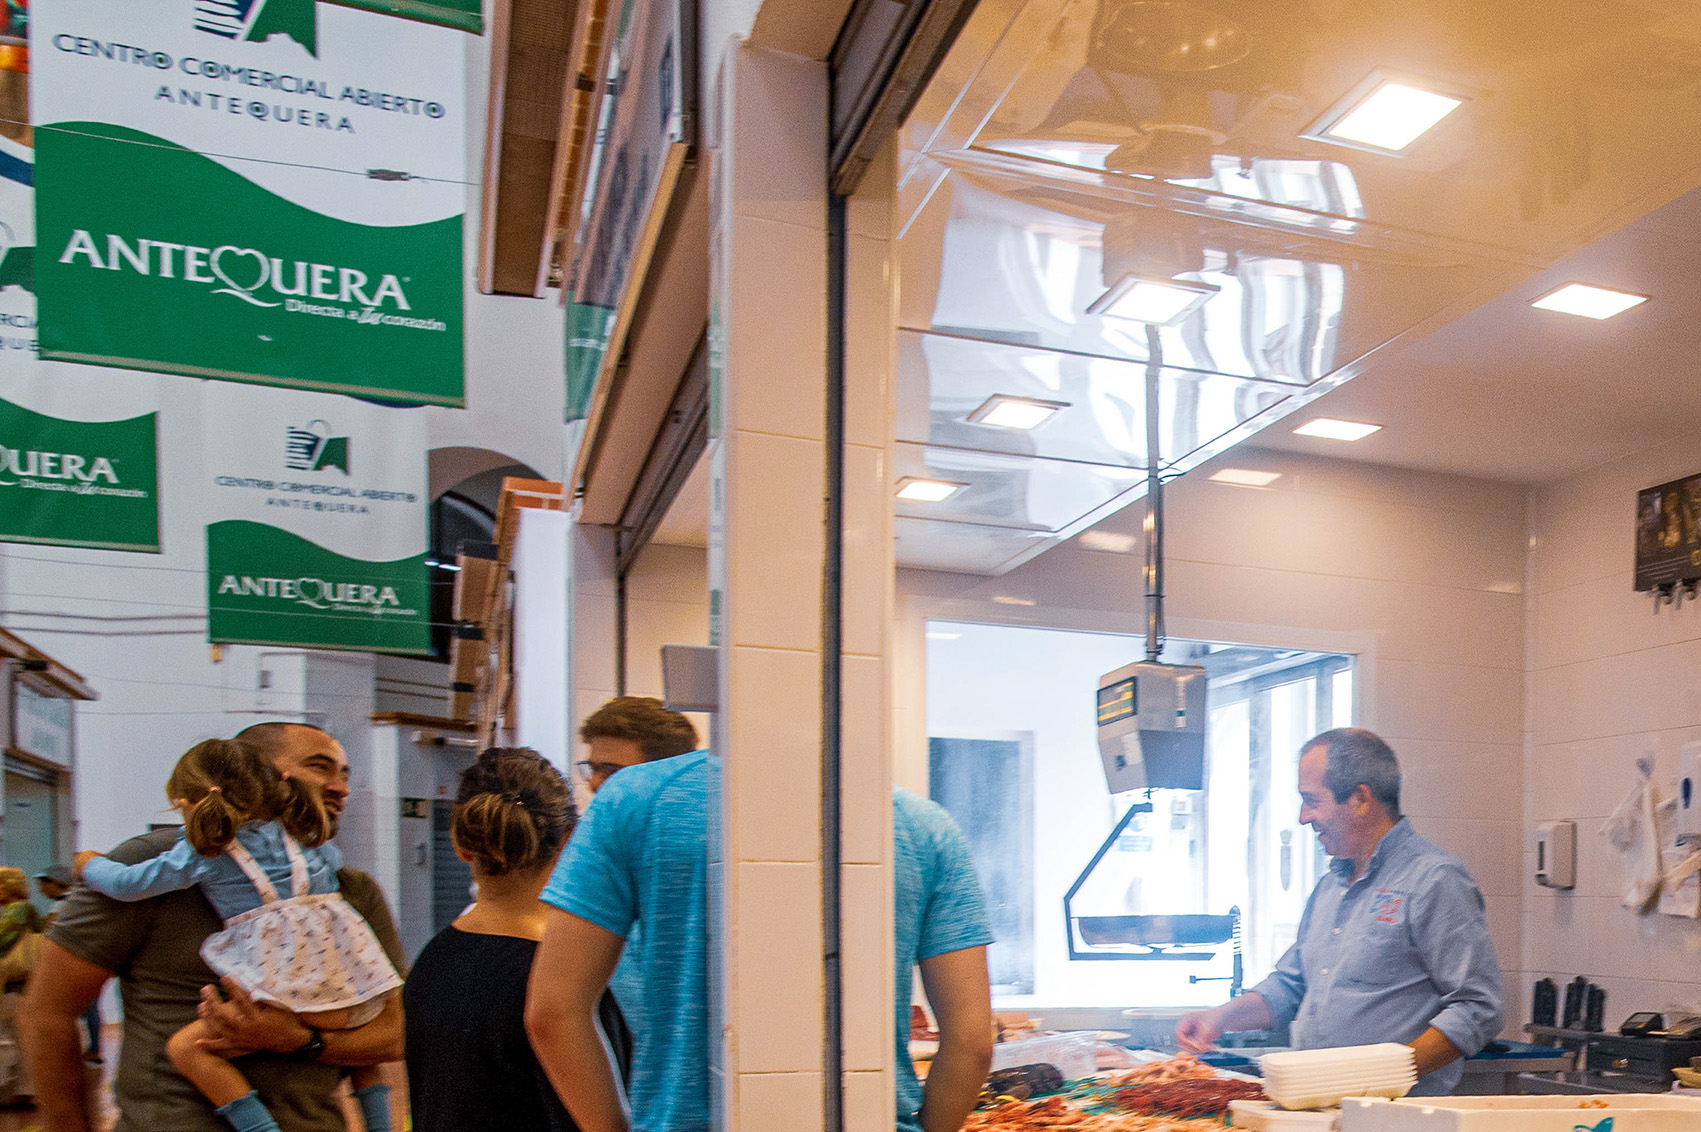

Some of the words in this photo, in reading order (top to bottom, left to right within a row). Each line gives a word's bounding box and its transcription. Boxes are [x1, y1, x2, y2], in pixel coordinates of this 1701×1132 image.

[52, 33, 173, 69] CENTRO
[179, 57, 334, 100] COMERCIAL
[339, 86, 446, 119] ABIERTO
[154, 85, 356, 134] ANTEQUERA
[58, 229, 411, 310] ANTEQUERA
[0, 444, 120, 484] UERA
[217, 574, 400, 609] ANTEQUERA
